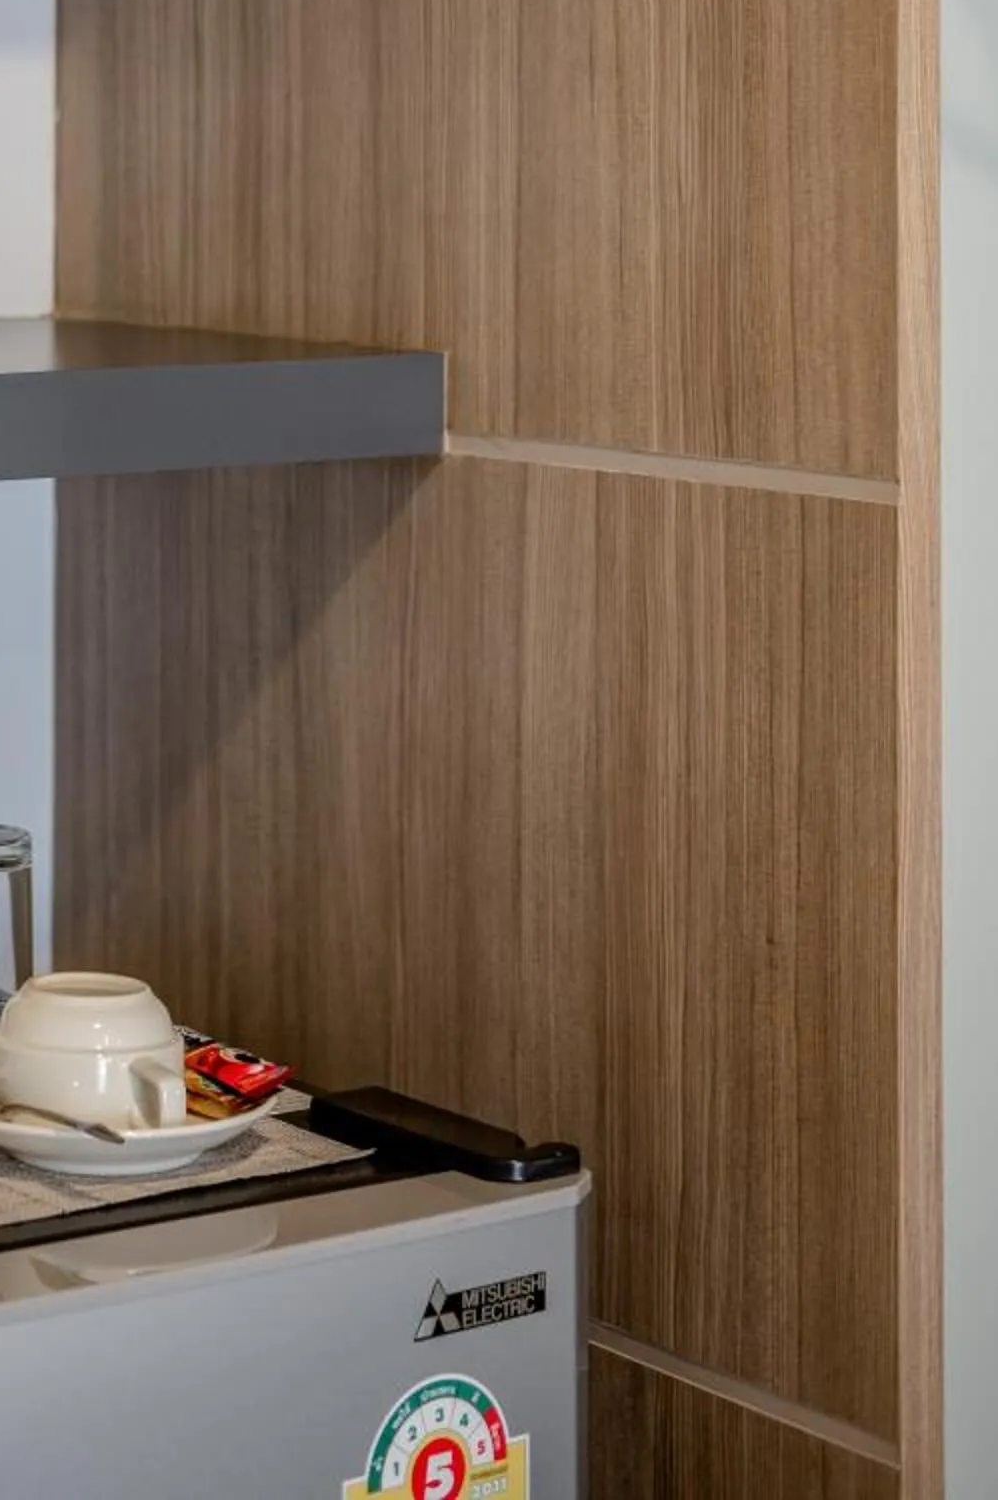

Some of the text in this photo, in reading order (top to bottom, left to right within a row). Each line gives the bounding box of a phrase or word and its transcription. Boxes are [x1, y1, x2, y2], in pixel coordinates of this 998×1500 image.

[461, 1272, 546, 1309] MITSUBISHI
[461, 1295, 536, 1328] ELECTRIC
[459, 1413, 470, 1427] 4
[407, 1426, 418, 1441] 2
[476, 1438, 486, 1456] 5
[393, 1462, 400, 1476] 1
[423, 1451, 455, 1500] 5
